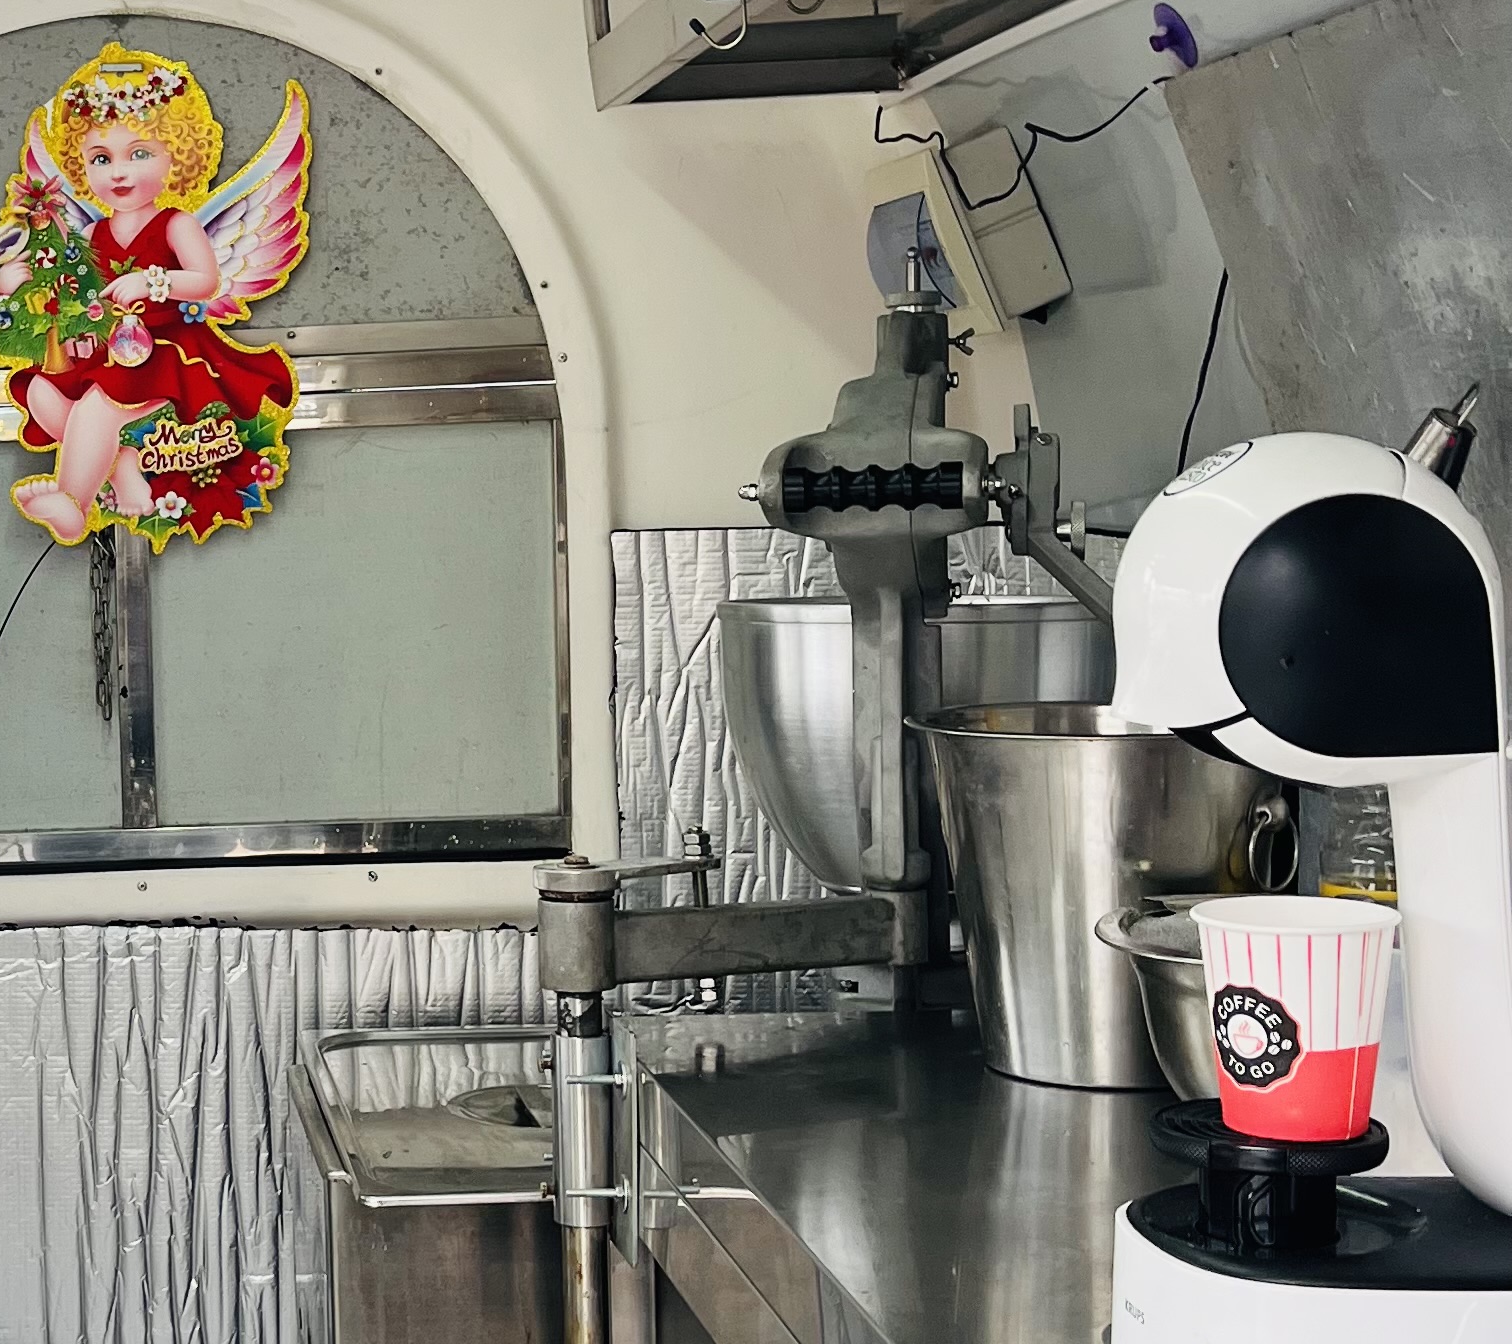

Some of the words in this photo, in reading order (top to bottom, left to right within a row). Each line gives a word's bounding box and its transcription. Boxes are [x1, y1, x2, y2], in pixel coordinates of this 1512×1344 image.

[1217, 994, 1283, 1029] COFFEE
[1228, 1054, 1246, 1076] TO
[1249, 1061, 1275, 1079] GO
